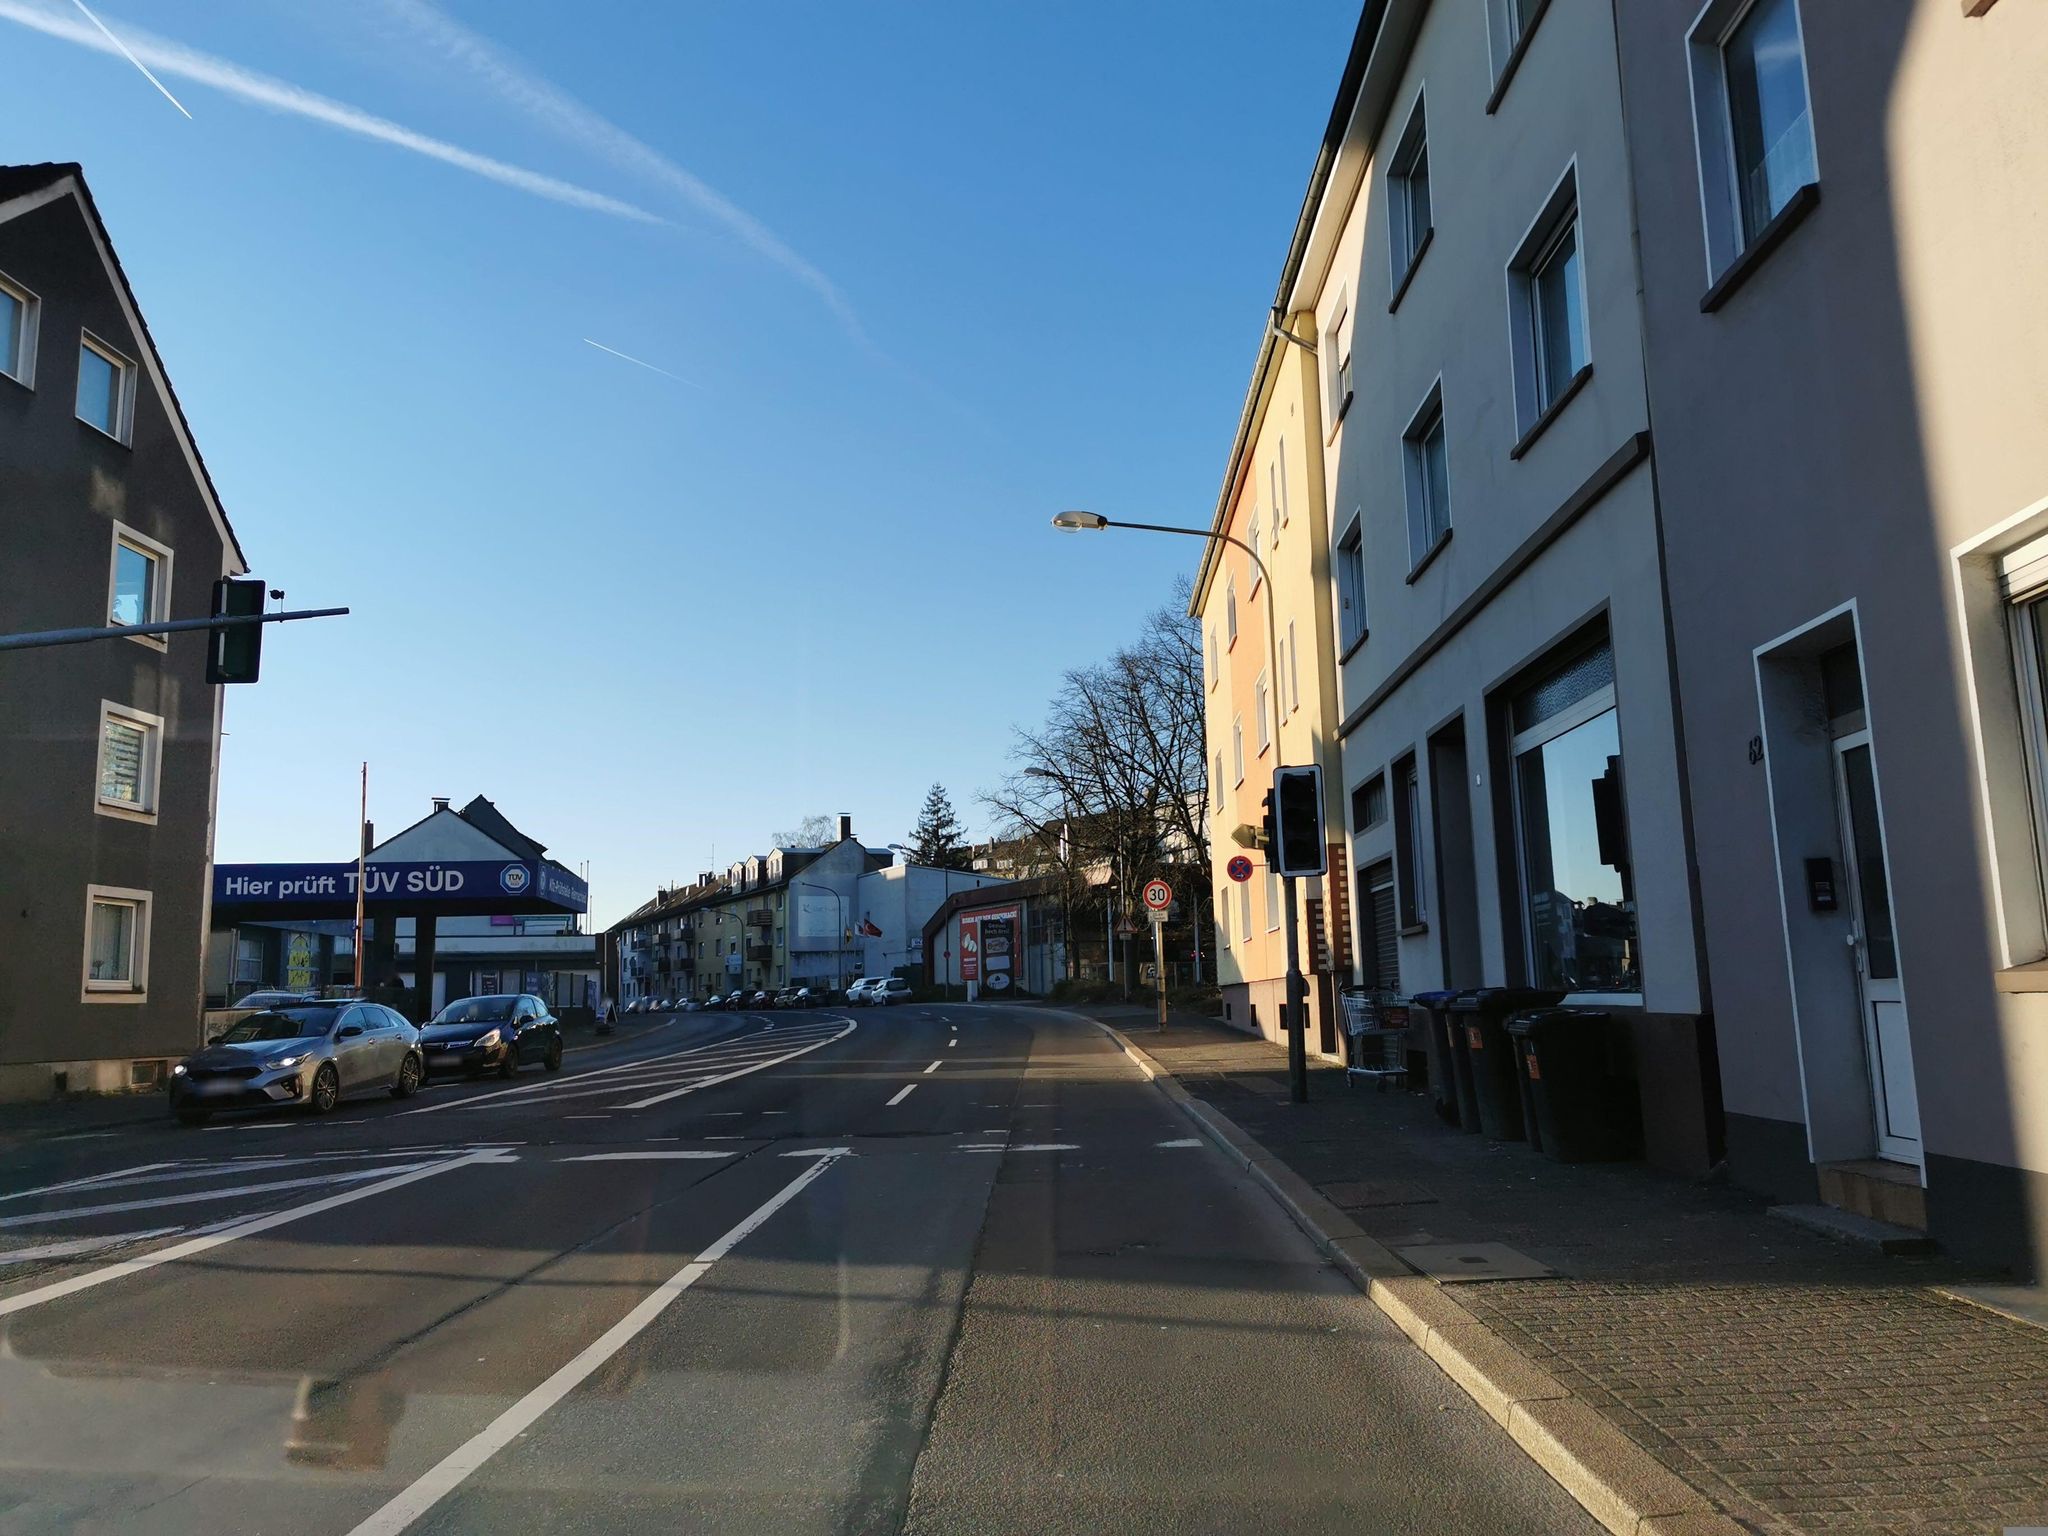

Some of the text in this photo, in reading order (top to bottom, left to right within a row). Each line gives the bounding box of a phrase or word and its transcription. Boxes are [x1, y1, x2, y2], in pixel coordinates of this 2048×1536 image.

[225, 865, 464, 899] Hier prüft TÜV SÜD
[1149, 888, 1165, 901] 30
